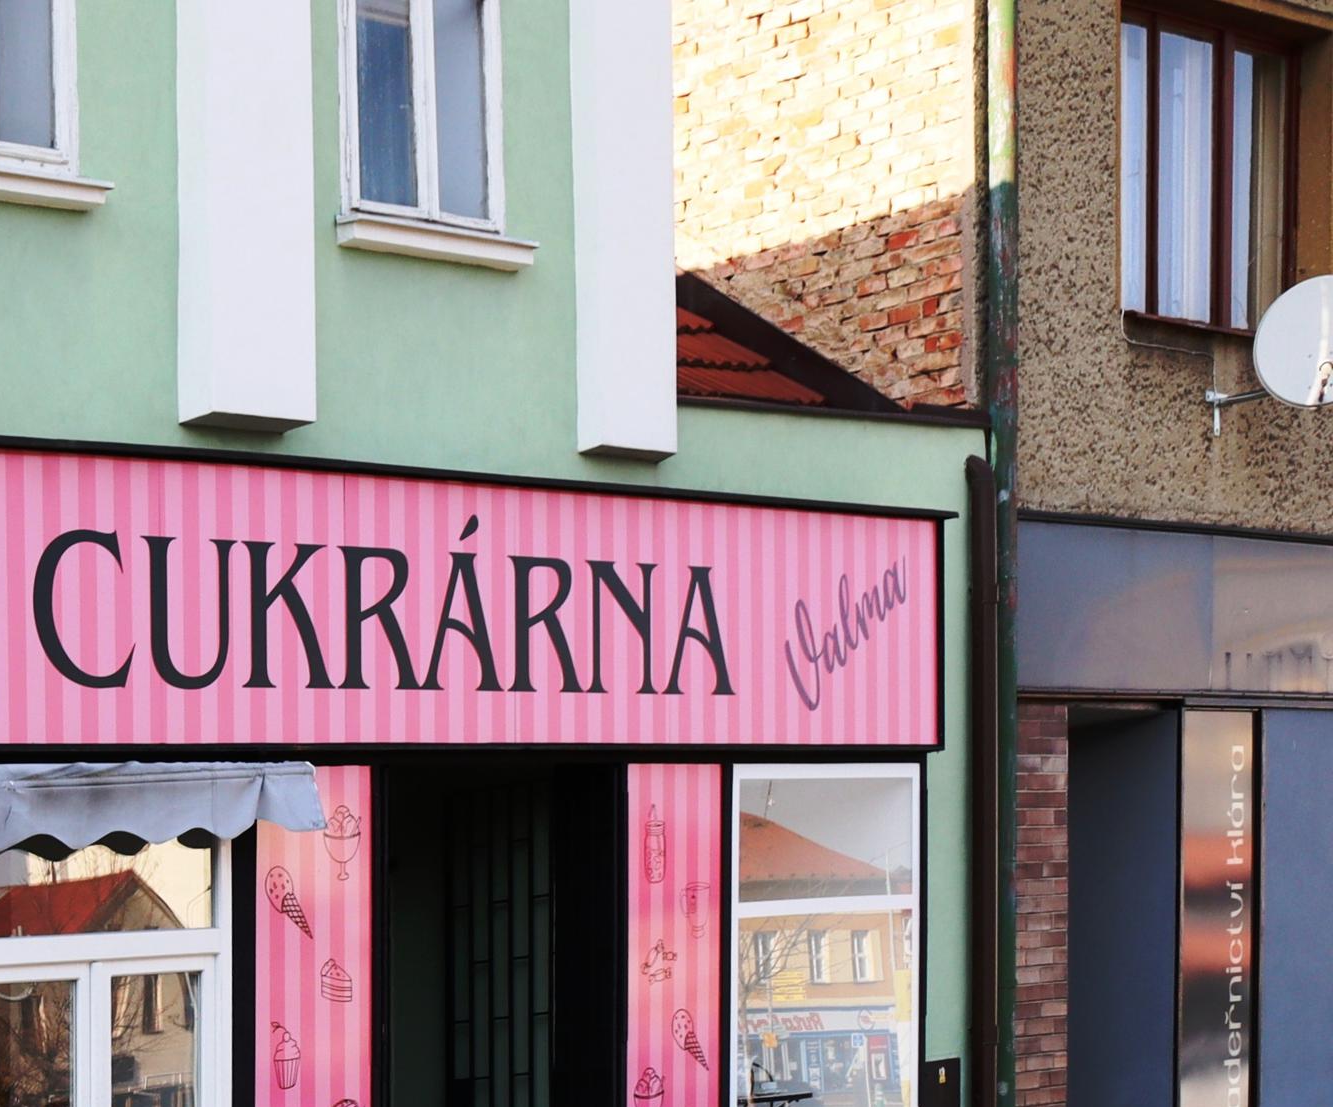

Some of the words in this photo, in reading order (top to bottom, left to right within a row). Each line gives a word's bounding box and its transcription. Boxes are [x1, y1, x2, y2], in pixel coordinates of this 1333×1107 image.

[31, 513, 736, 696] CUKRÁRNA
[782, 553, 909, 713] Valma
[1226, 745, 1245, 865] klára
